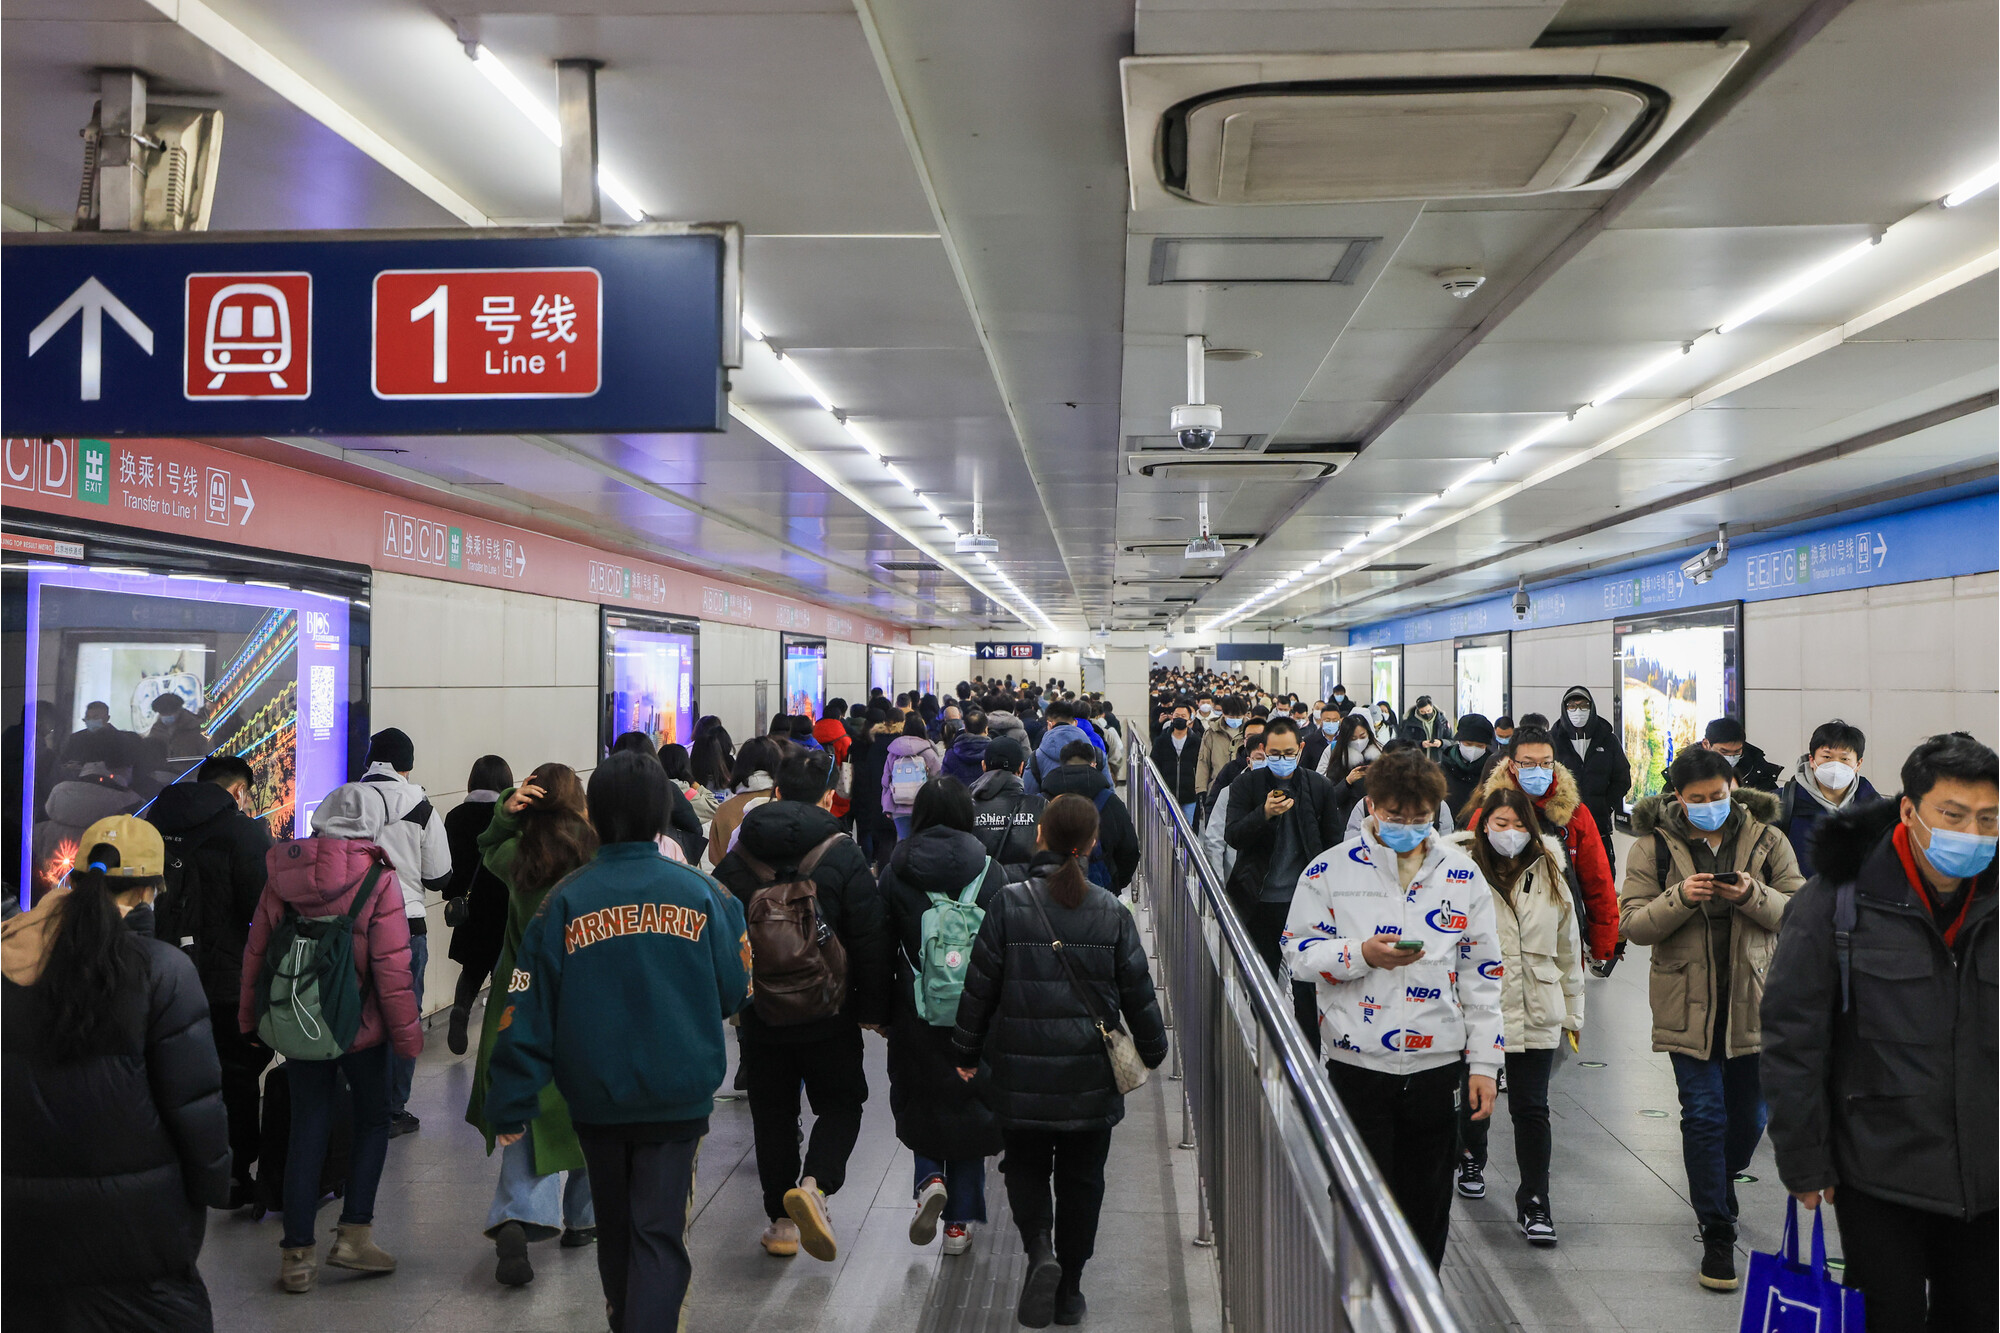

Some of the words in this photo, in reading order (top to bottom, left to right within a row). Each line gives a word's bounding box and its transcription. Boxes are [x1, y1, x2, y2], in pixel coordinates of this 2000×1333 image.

[411, 285, 448, 383] 1
[485, 350, 546, 375] Line
[555, 350, 567, 373] 1
[5, 439, 30, 482] C
[45, 440, 68, 488] D
[86, 450, 103, 481] 出
[120, 449, 198, 498] 换乘1号线
[85, 481, 102, 494] EXIT
[122, 490, 160, 513] Transfer
[162, 499, 170, 515] to
[172, 500, 191, 519] Line
[193, 504, 197, 520] 1
[38, 543, 53, 552] METRO
[386, 518, 397, 552] A
[404, 521, 413, 555] B
[419, 525, 430, 558] C
[435, 528, 445, 560] D
[452, 534, 460, 554] 出
[466, 532, 500, 560] 换乘1号线
[1810, 538, 1854, 566] 换乘10号线
[466, 558, 483, 572] Transfer
[488, 564, 496, 574] Line
[1772, 556, 1780, 584] F
[1784, 553, 1794, 581] G
[1798, 552, 1807, 571] 出
[1812, 568, 1830, 580] Transfer
[565, 903, 707, 955] MRNEARLY
[1406, 986, 1441, 1000] NBA
